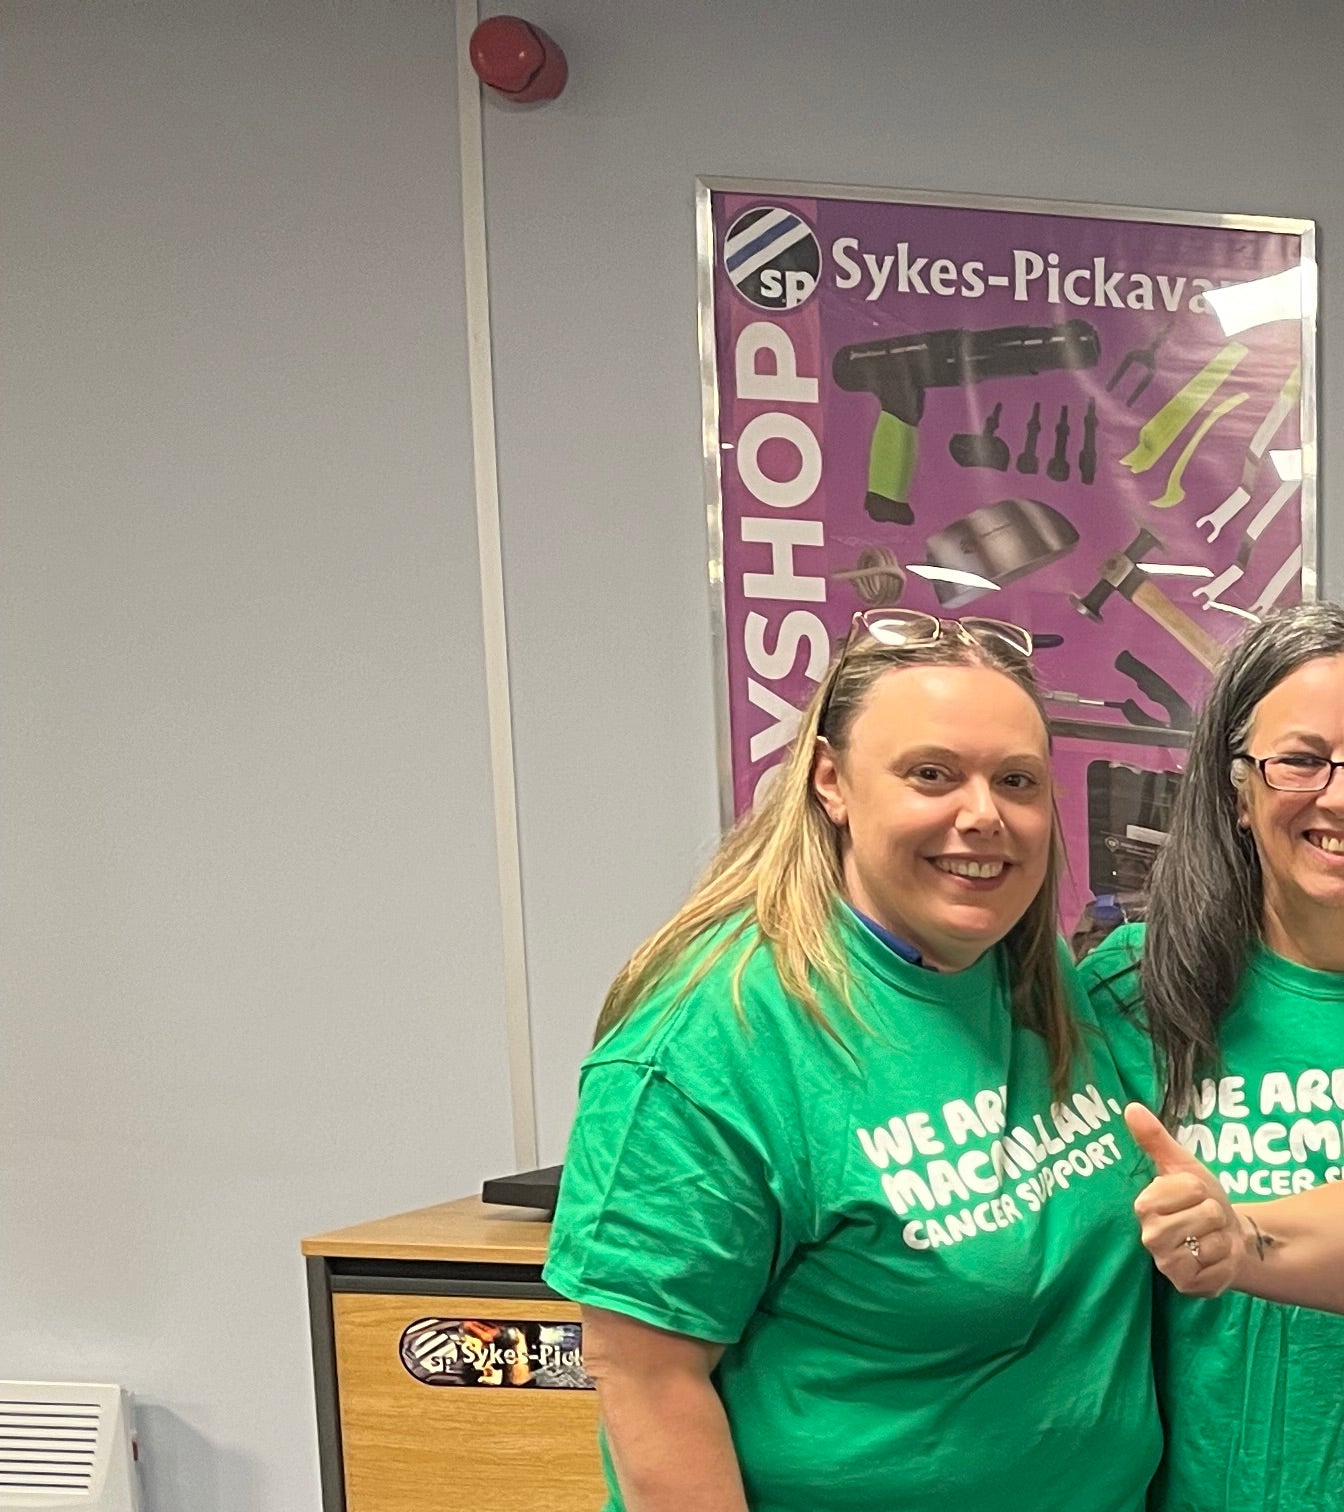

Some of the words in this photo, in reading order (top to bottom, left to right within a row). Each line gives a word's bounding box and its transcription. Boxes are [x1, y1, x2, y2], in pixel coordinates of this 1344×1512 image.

[831, 237, 1245, 314] Sykes-Pickava
[735, 321, 830, 812] YSHOP
[857, 1112, 945, 1170] WE
[902, 1193, 1023, 1250] CANCER
[1015, 1132, 1122, 1212] SUPPORT
[1218, 1169, 1317, 1196] NCER
